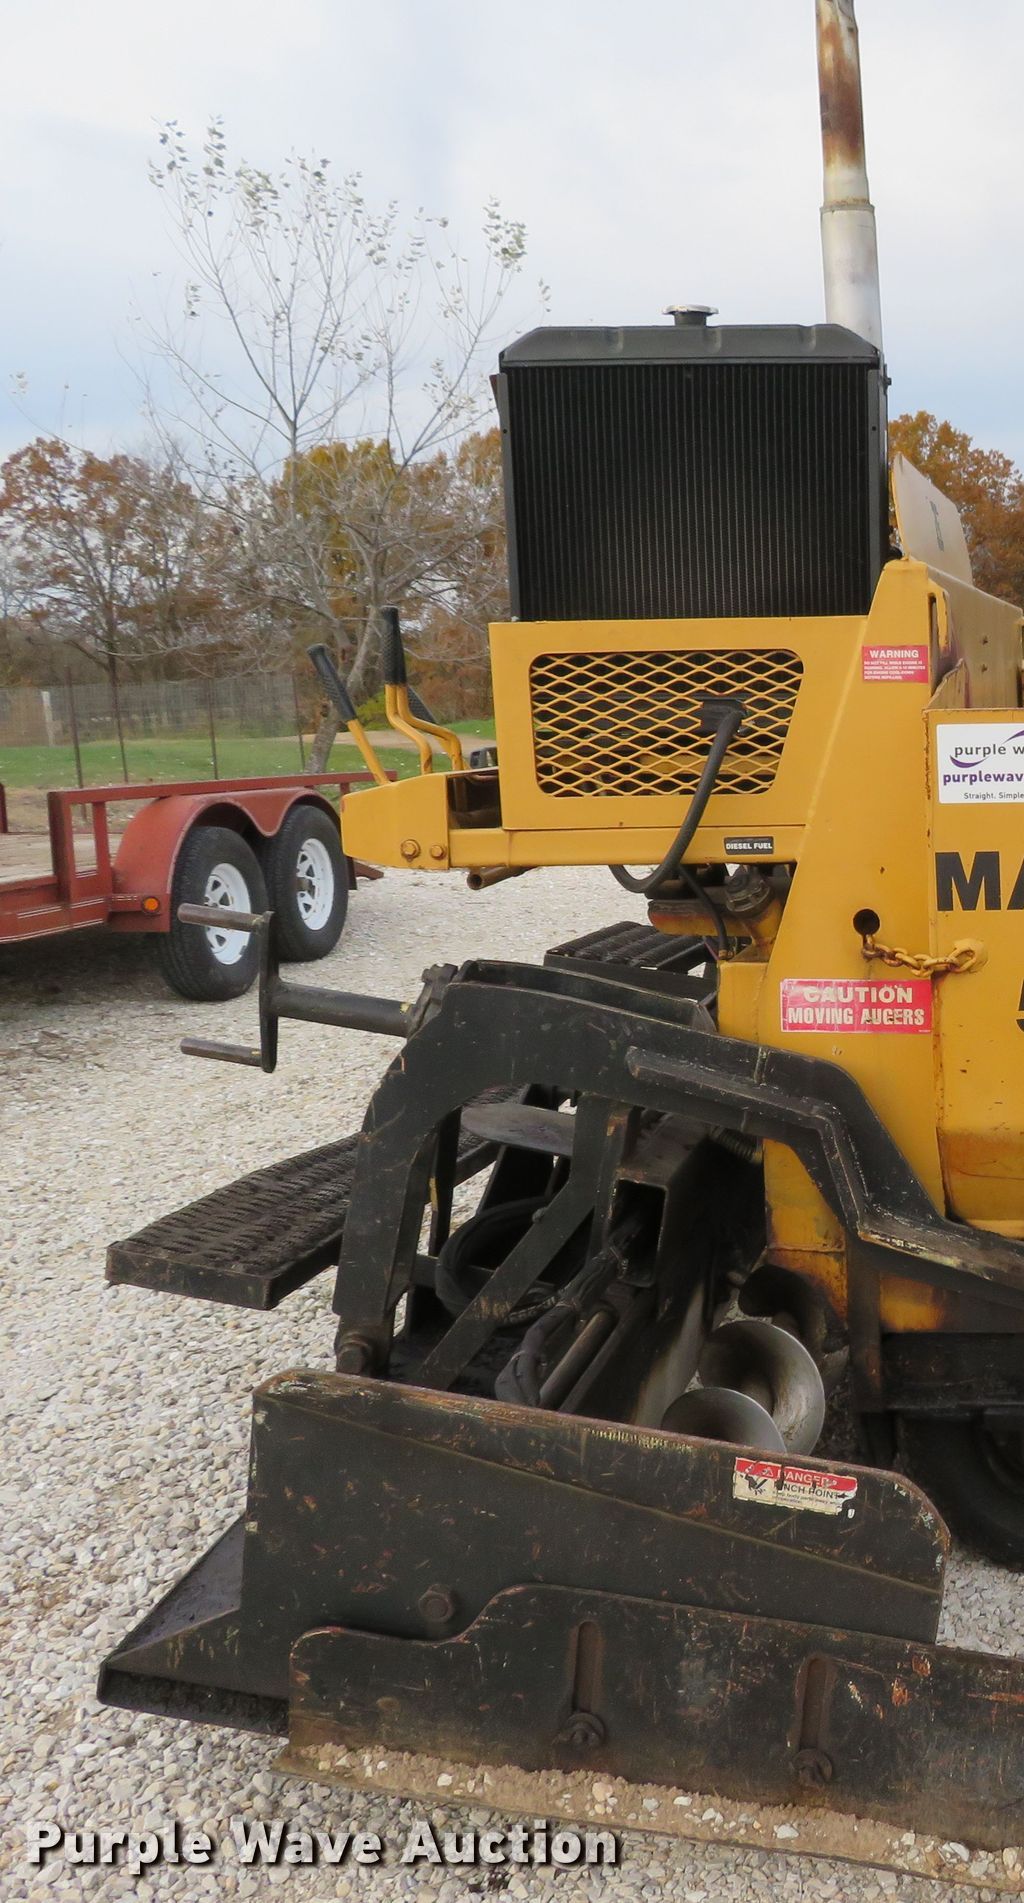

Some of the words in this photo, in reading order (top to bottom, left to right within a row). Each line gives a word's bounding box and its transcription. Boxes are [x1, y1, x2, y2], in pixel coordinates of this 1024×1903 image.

[869, 649, 919, 658] WARNING
[954, 743, 1007, 757] purple
[964, 792, 996, 800] Straight.
[803, 985, 913, 1004] CAUTION
[787, 1006, 854, 1025] MOVING
[860, 1007, 925, 1026] AUGERS
